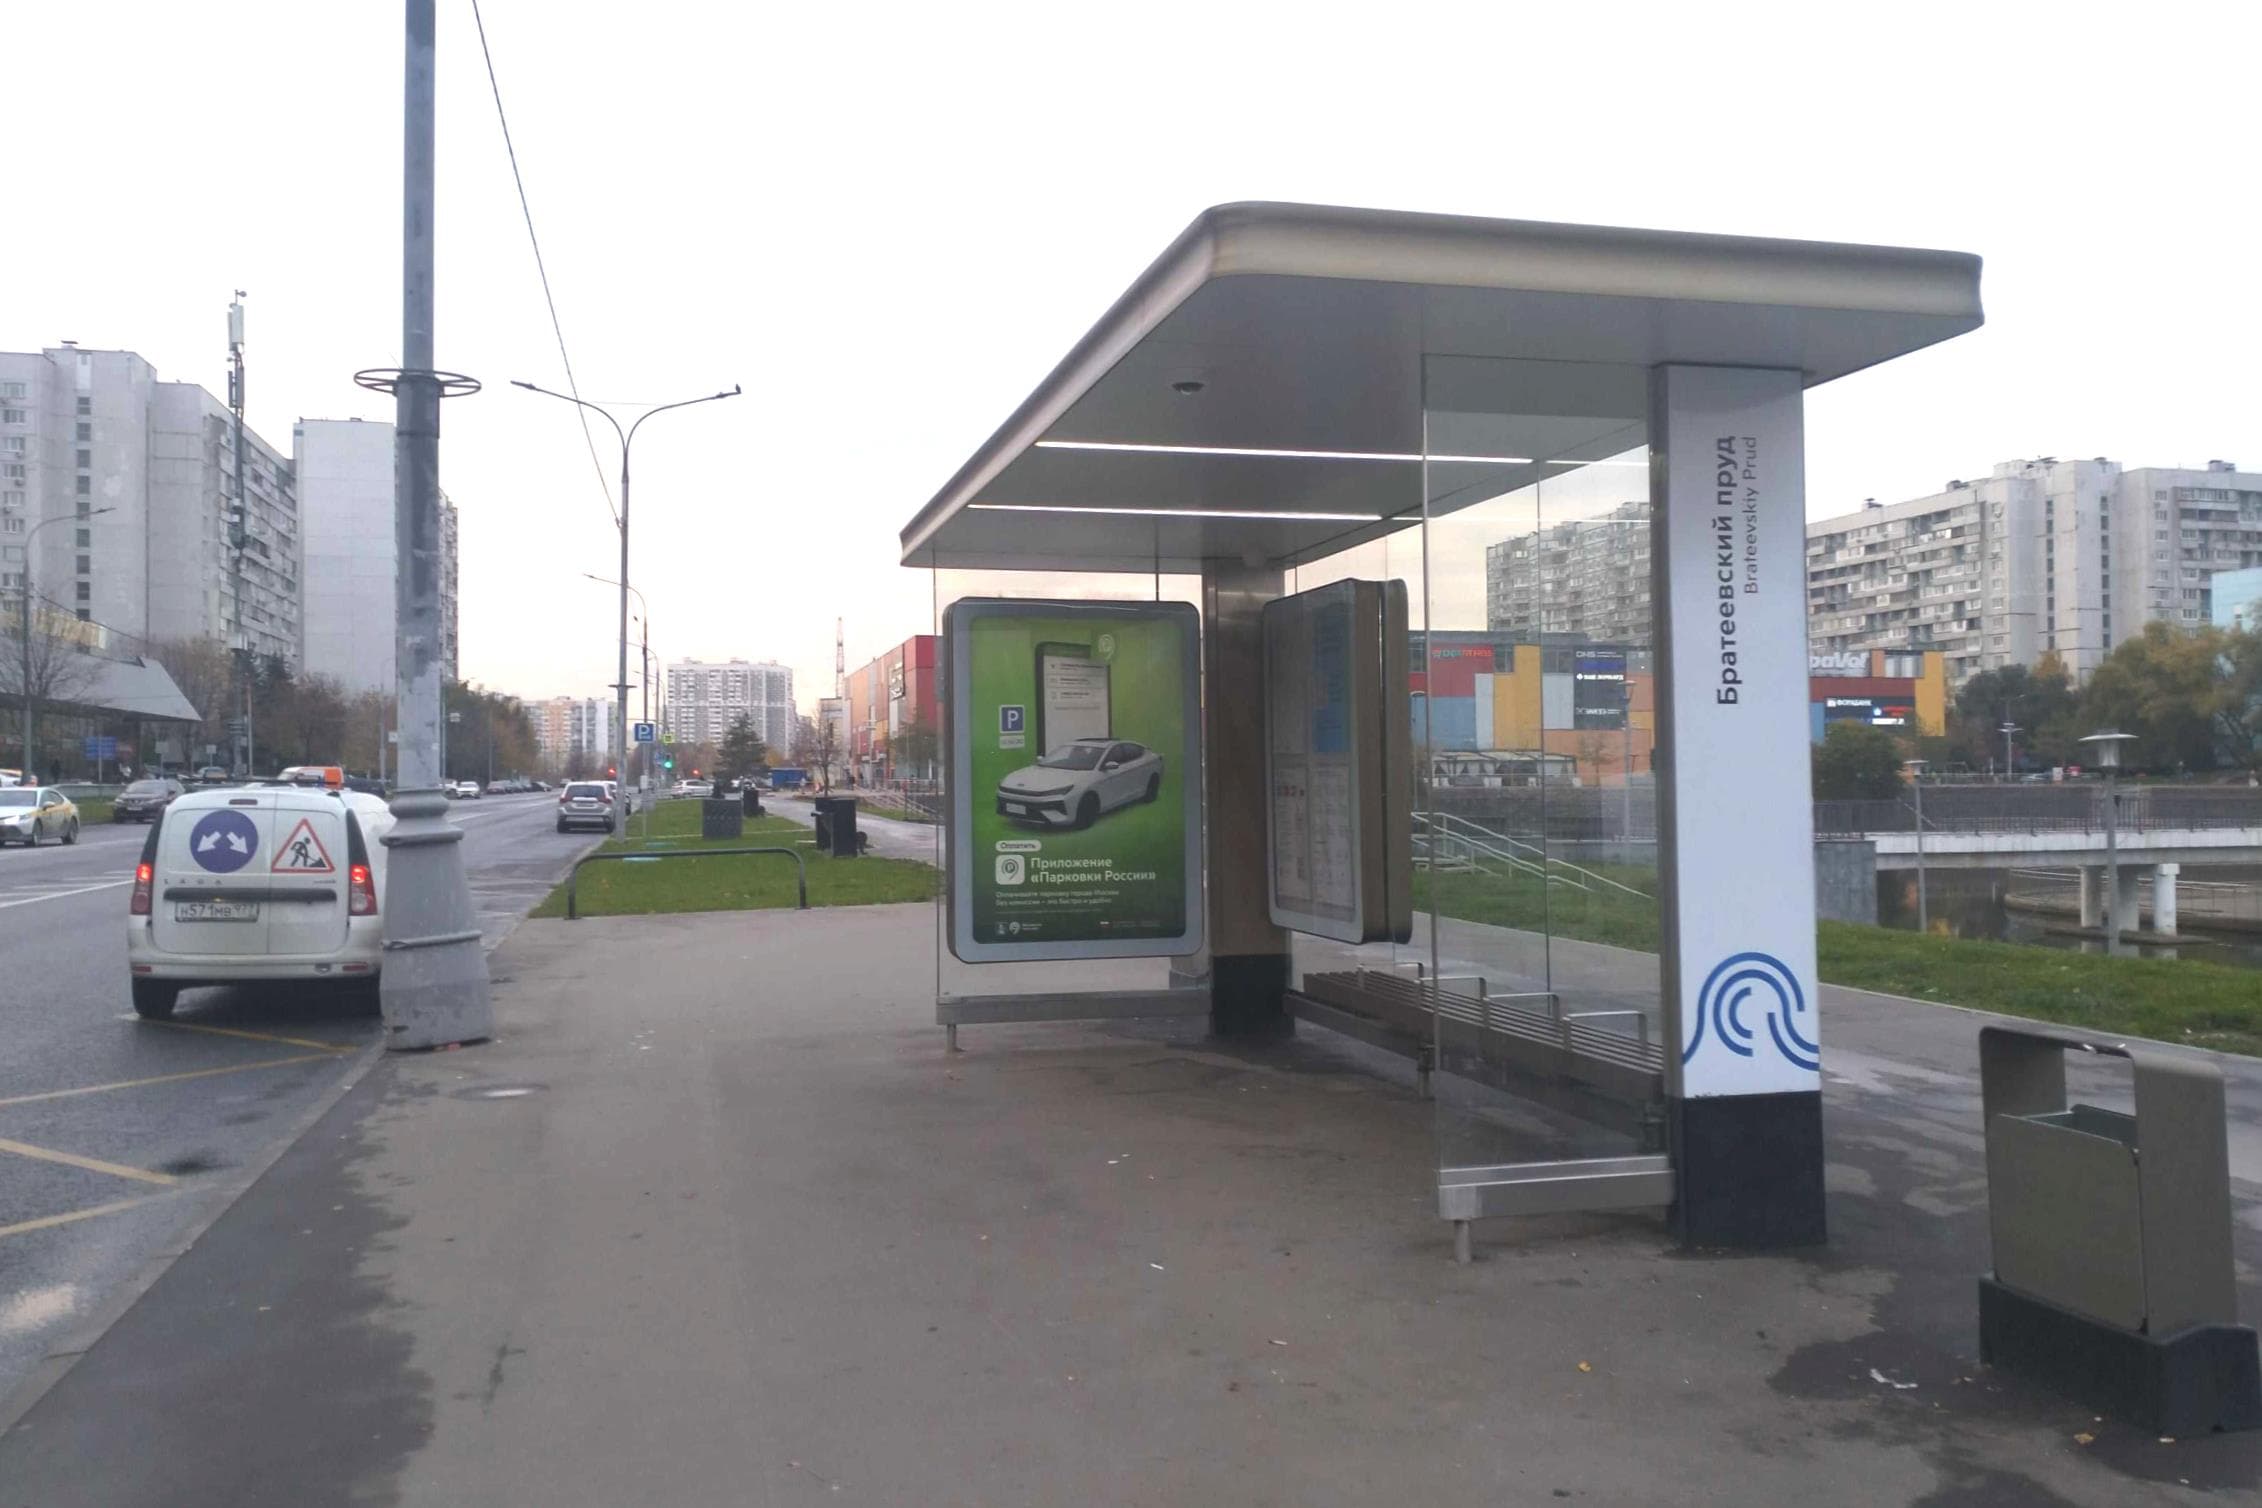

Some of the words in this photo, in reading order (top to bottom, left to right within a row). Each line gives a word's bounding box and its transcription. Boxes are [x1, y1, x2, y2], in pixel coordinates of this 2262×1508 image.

[1716, 435, 1738, 506] пруд
[1741, 436, 1757, 480] Prud
[1742, 487, 1759, 594] Brateevskiy
[1712, 515, 1742, 705] Братеевский
[1030, 857, 1112, 870] Приложение
[1030, 871, 1102, 884] «Парковки
[1105, 870, 1156, 881] России»
